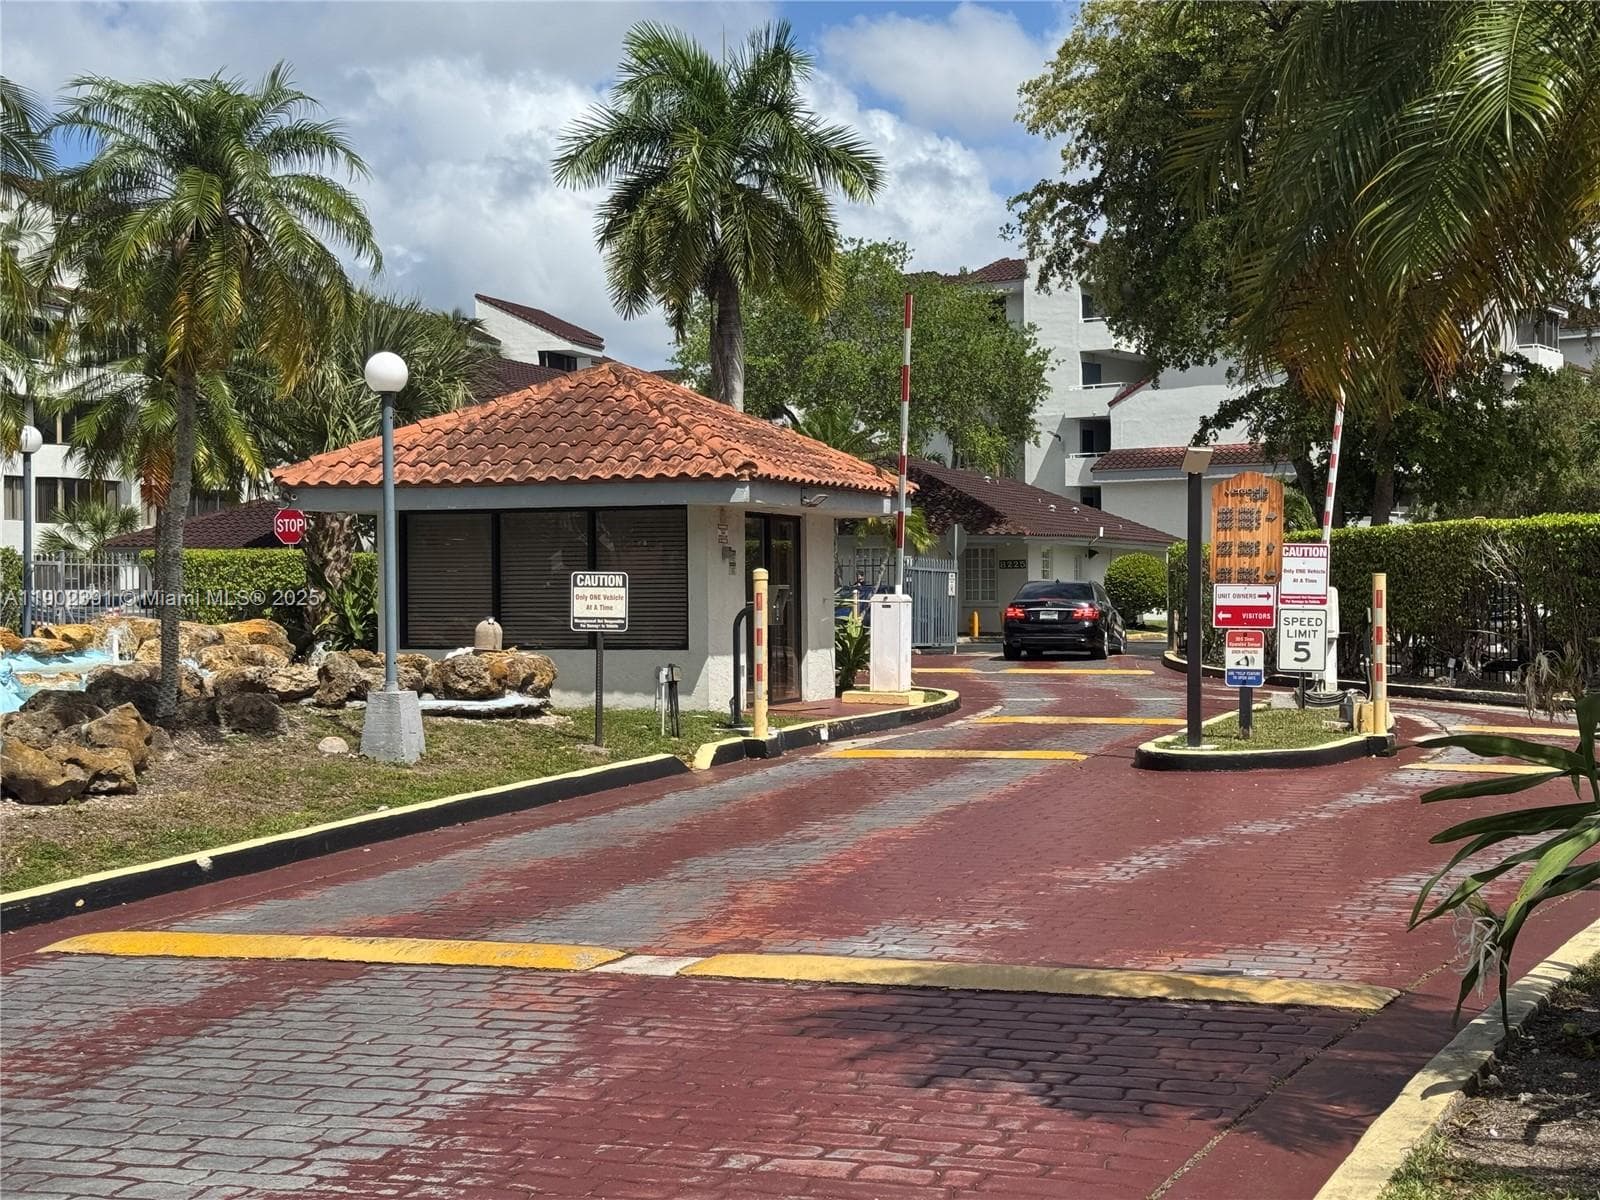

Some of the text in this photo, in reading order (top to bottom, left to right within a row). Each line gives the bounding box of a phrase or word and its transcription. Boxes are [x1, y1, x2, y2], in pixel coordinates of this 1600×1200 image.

[276, 518, 304, 533] STOP
[1281, 546, 1328, 557] CAUTION
[576, 574, 623, 587] CAUTION
[1241, 612, 1271, 620] VISITORS
[1283, 617, 1323, 627] SPEED
[1286, 629, 1319, 639] LIMIT
[1293, 641, 1311, 663] 5
